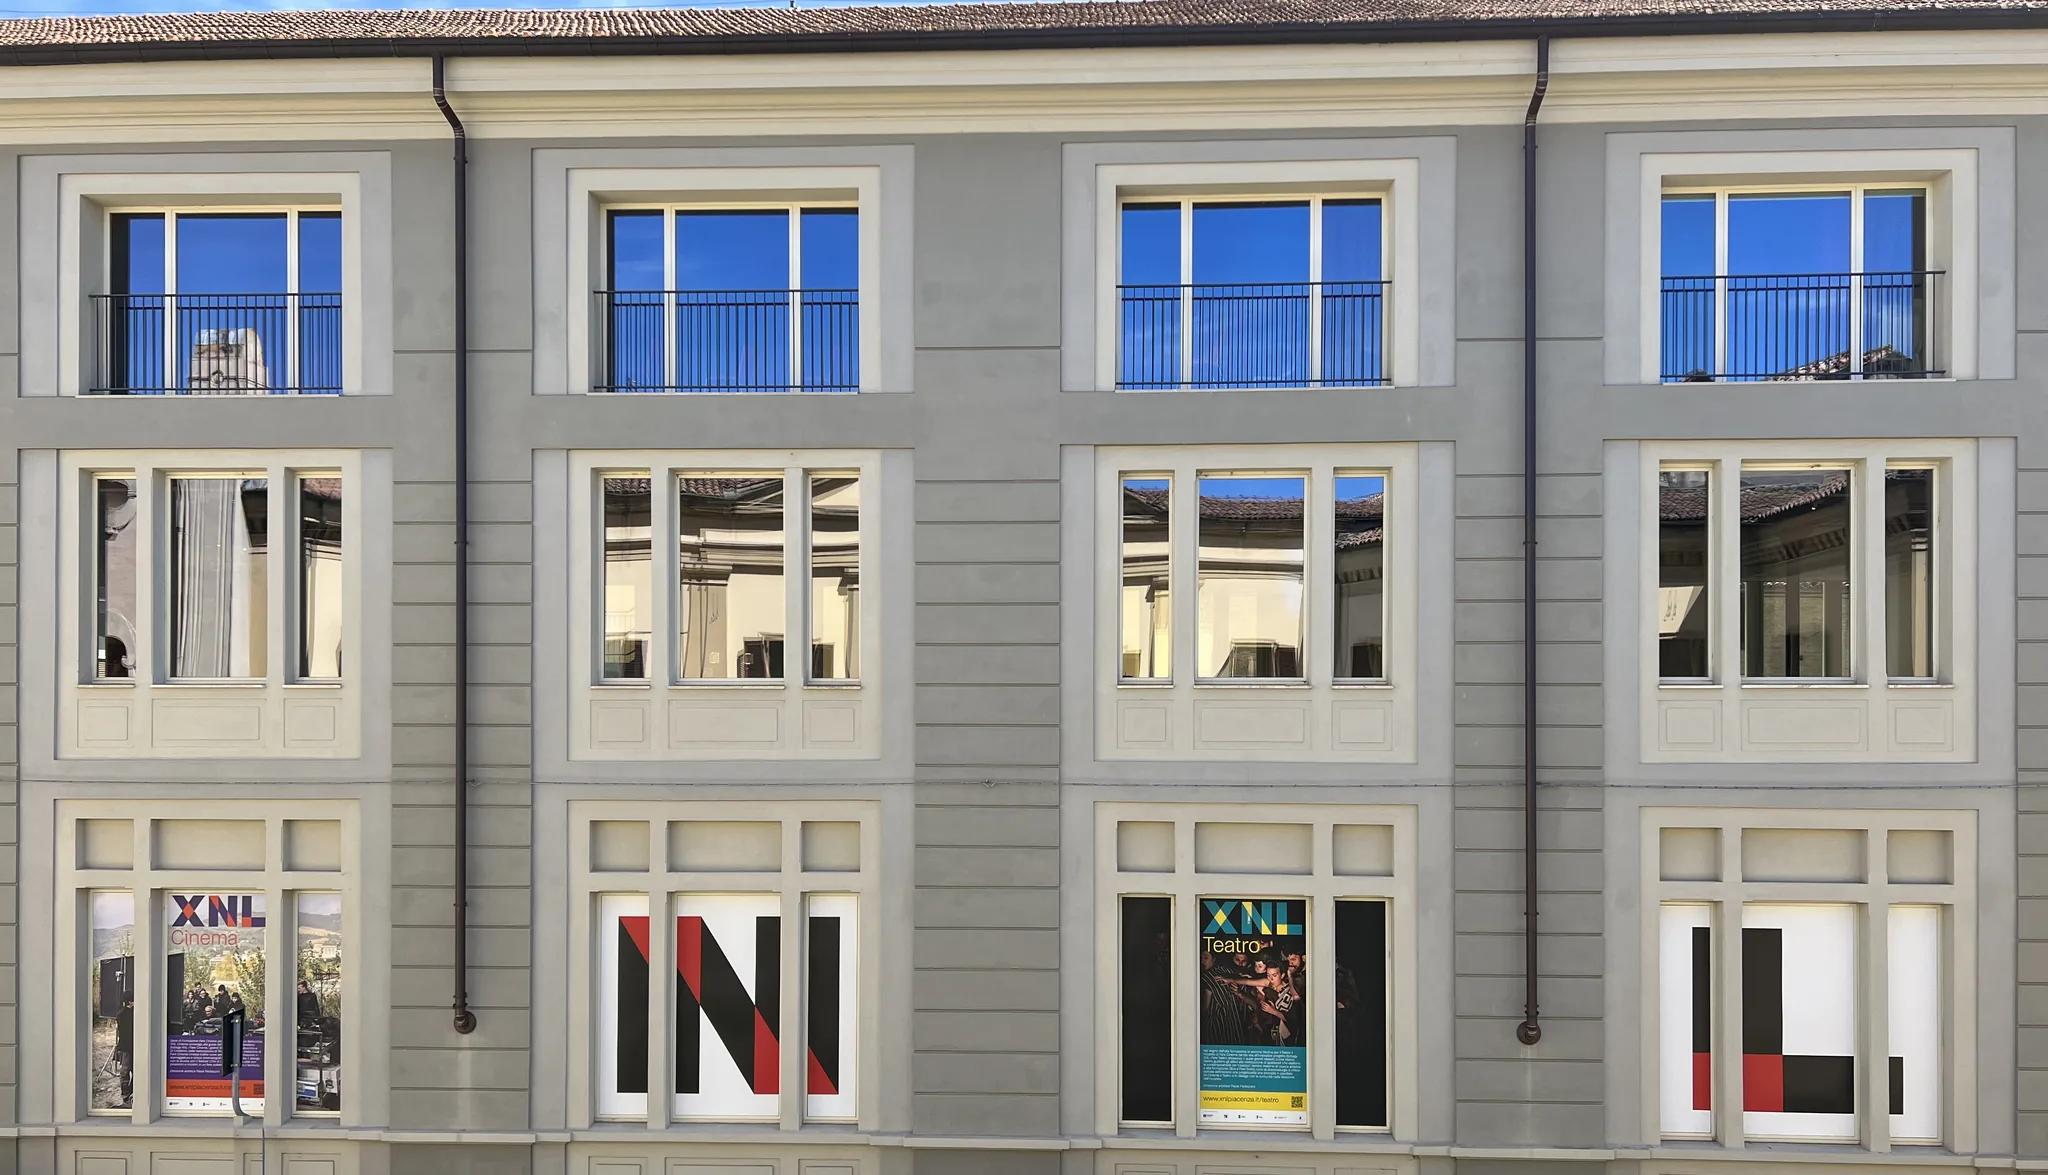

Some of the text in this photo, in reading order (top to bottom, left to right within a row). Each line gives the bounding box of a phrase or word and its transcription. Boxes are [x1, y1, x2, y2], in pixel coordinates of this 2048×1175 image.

[172, 895, 265, 927] XNL
[1203, 901, 1302, 935] XNL
[171, 929, 239, 946] Cinema
[1203, 936, 1260, 954] Teatro
[617, 916, 840, 1094] N
